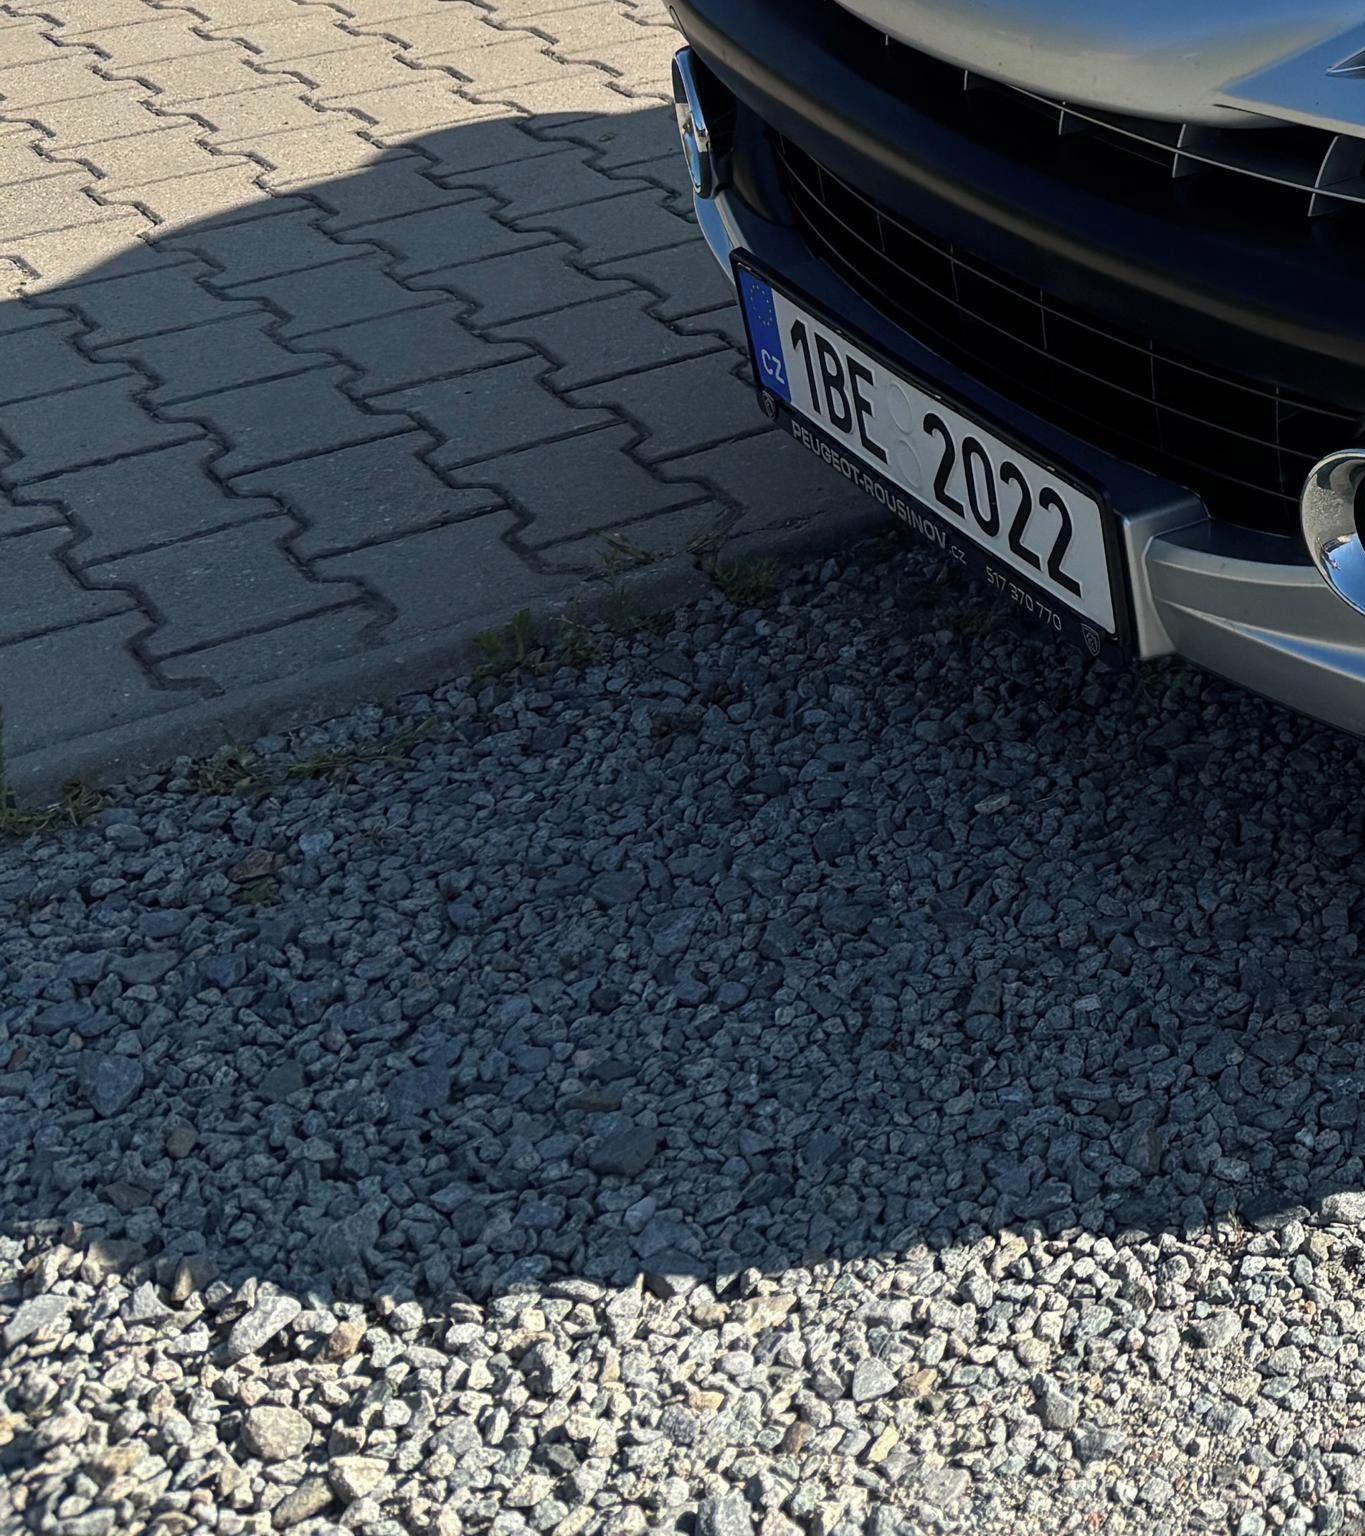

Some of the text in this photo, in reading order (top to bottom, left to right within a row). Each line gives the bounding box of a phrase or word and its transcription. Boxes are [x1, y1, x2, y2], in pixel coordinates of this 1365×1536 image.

[760, 348, 786, 386] CZ
[789, 317, 1082, 599] 1BE 2022
[985, 566, 1063, 632] 517 370 770
